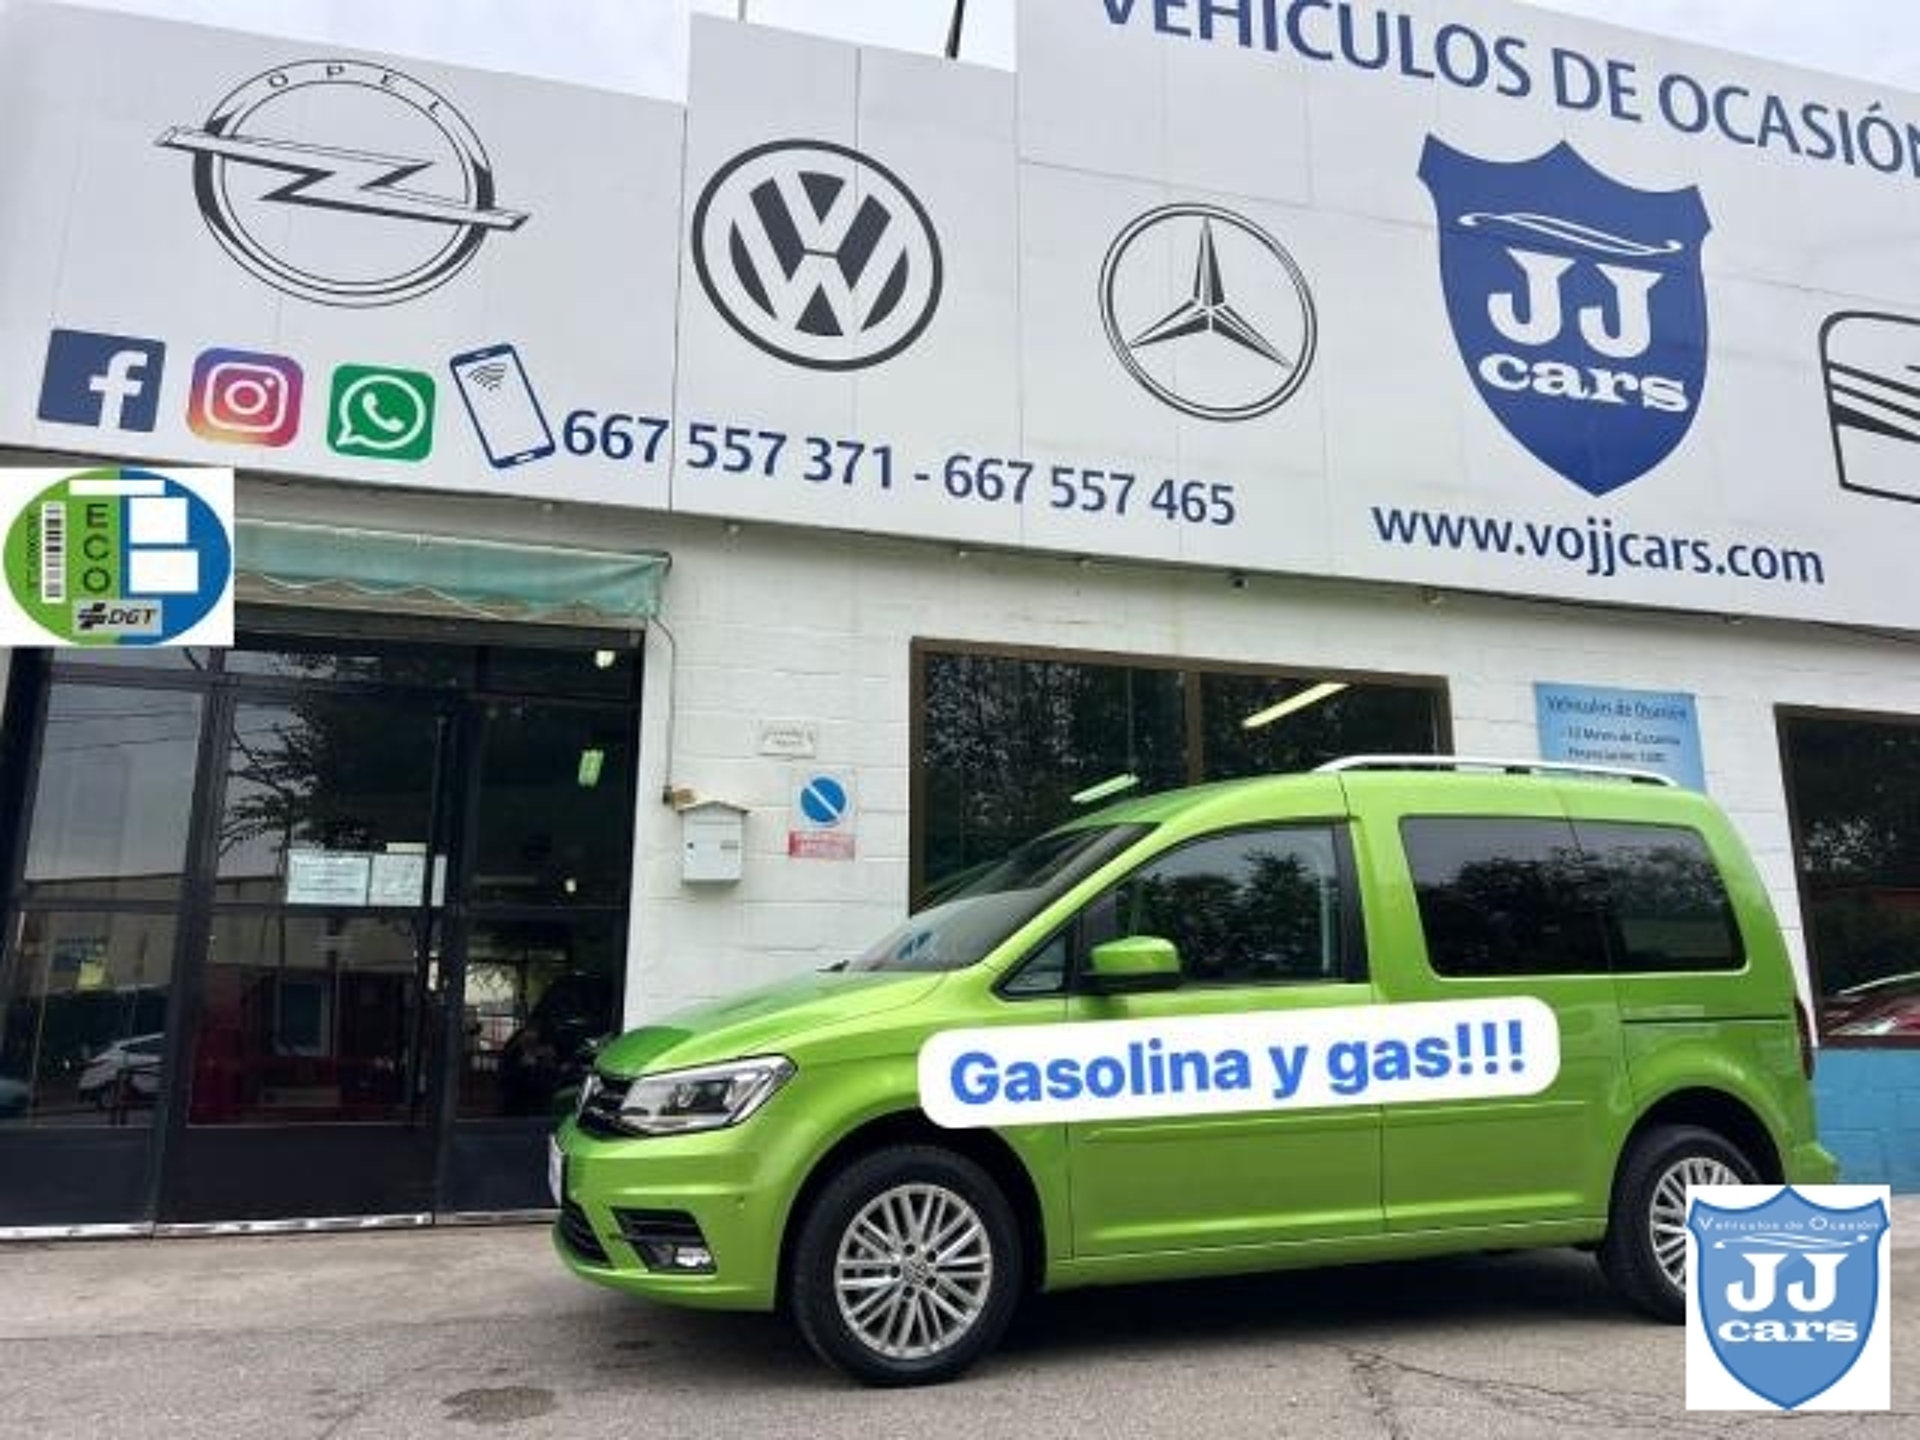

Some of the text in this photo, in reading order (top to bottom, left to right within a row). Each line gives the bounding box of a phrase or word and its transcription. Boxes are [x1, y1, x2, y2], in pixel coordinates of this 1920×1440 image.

[268, 63, 441, 118] OPEL
[1552, 48, 1642, 122] DE
[1487, 247, 1663, 358] JJ
[1478, 353, 1689, 412] cars
[563, 411, 670, 462] 667
[687, 422, 787, 477] 557
[804, 437, 893, 488] 371
[944, 454, 1033, 503] 667
[1050, 466, 1136, 516] 557
[1151, 479, 1236, 527] 465
[1371, 505, 1826, 585] www.vojjcars.com
